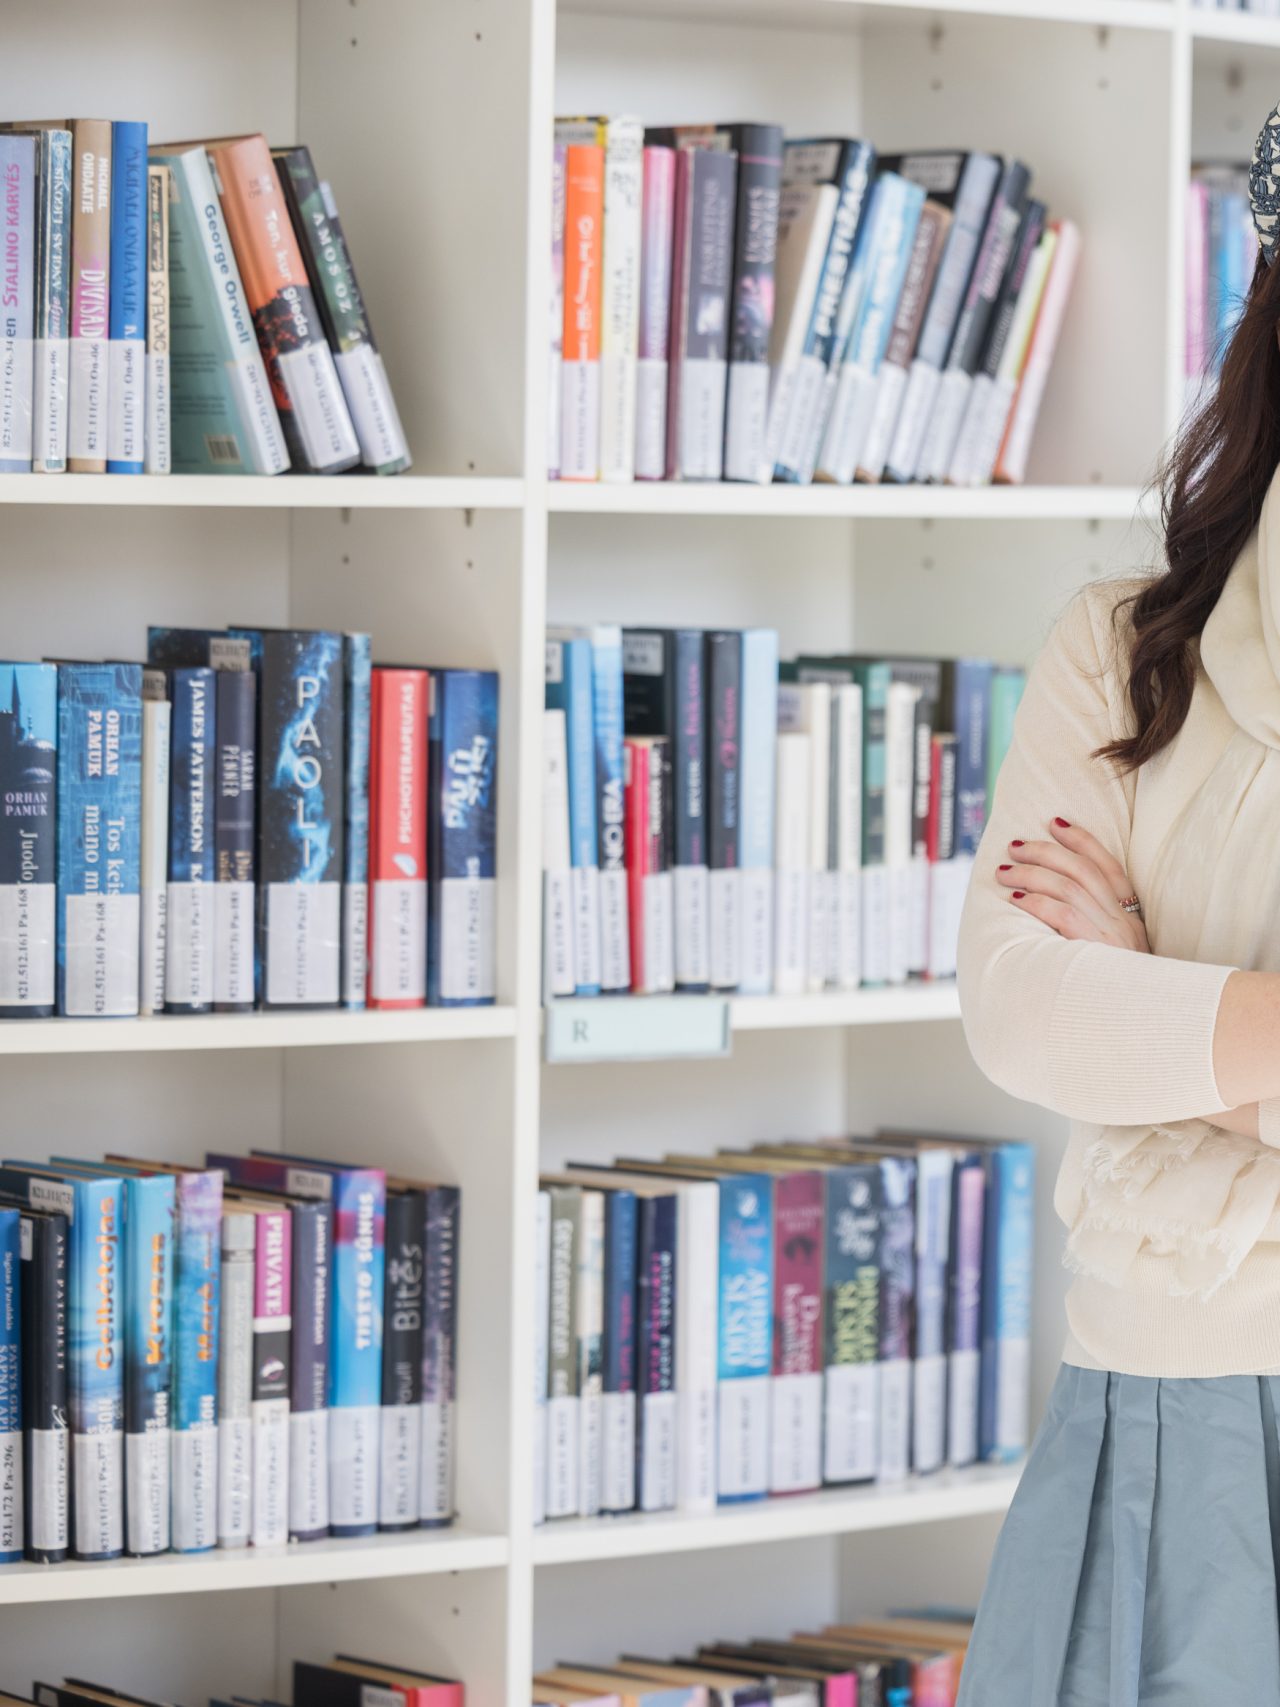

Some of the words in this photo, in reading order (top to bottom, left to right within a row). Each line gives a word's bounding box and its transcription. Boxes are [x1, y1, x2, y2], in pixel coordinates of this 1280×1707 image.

[3, 231, 18, 307] STALINO
[203, 204, 232, 275] George
[225, 281, 250, 344] Orwell
[312, 211, 342, 276] AMOS
[188, 679, 206, 738] JAMES
[87, 710, 102, 777] PAMUK
[106, 710, 119, 775] ORHAN
[222, 744, 239, 797] PENNER
[399, 682, 415, 844] PSICHOTERAPEUTAS
[5, 792, 48, 804] ORHAN
[5, 804, 48, 816] PAMUK
[190, 742, 204, 853] PATTERSON
[86, 804, 100, 863] mano
[109, 817, 125, 852] Tos
[573, 1020, 589, 1043] R
[56, 1234, 66, 1268] ANN
[314, 1214, 327, 1263] James
[353, 1192, 375, 1263] SŪNUS
[95, 1195, 120, 1370] Gelbėtojas
[266, 1216, 283, 1315] PRIVATE
[389, 1242, 422, 1331] Bitės
[144, 1232, 166, 1365] Krosas
[313, 1267, 327, 1345] Patterson
[356, 1268, 373, 1351] TIBETO
[3, 1445, 14, 1491] Pa-296
[3, 1495, 13, 1547] 821.172
